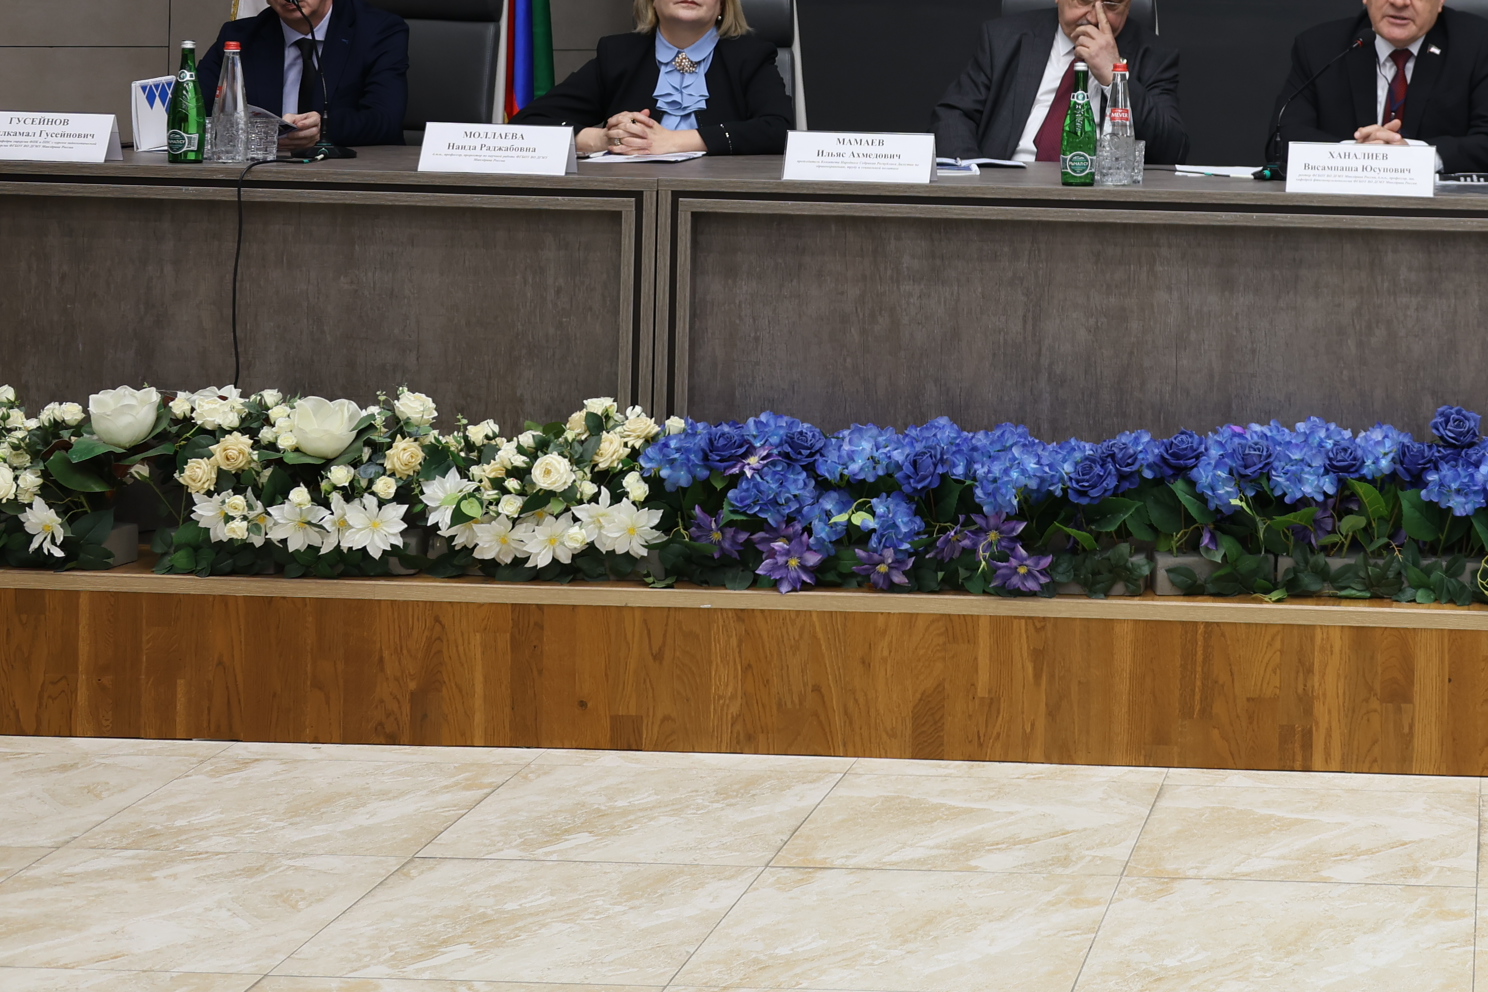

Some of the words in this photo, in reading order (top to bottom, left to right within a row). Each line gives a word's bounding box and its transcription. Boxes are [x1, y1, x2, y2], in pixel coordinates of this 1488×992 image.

[8, 115, 70, 126] ГУСЕЙНОВ
[0, 129, 36, 138] лкамал
[39, 129, 95, 139] Гусейнович
[463, 130, 525, 141] МОЛЛАЕВА
[447, 142, 478, 151] Наида
[480, 143, 537, 153] Раджабовна
[836, 137, 885, 147] МАМАЕВ
[816, 149, 847, 158] Ильяс
[849, 150, 901, 160] Ахмедович
[1328, 151, 1389, 160] ХАНАЛИЕВ
[1303, 162, 1359, 172] Висампаша
[1361, 164, 1411, 174] Юсупович
